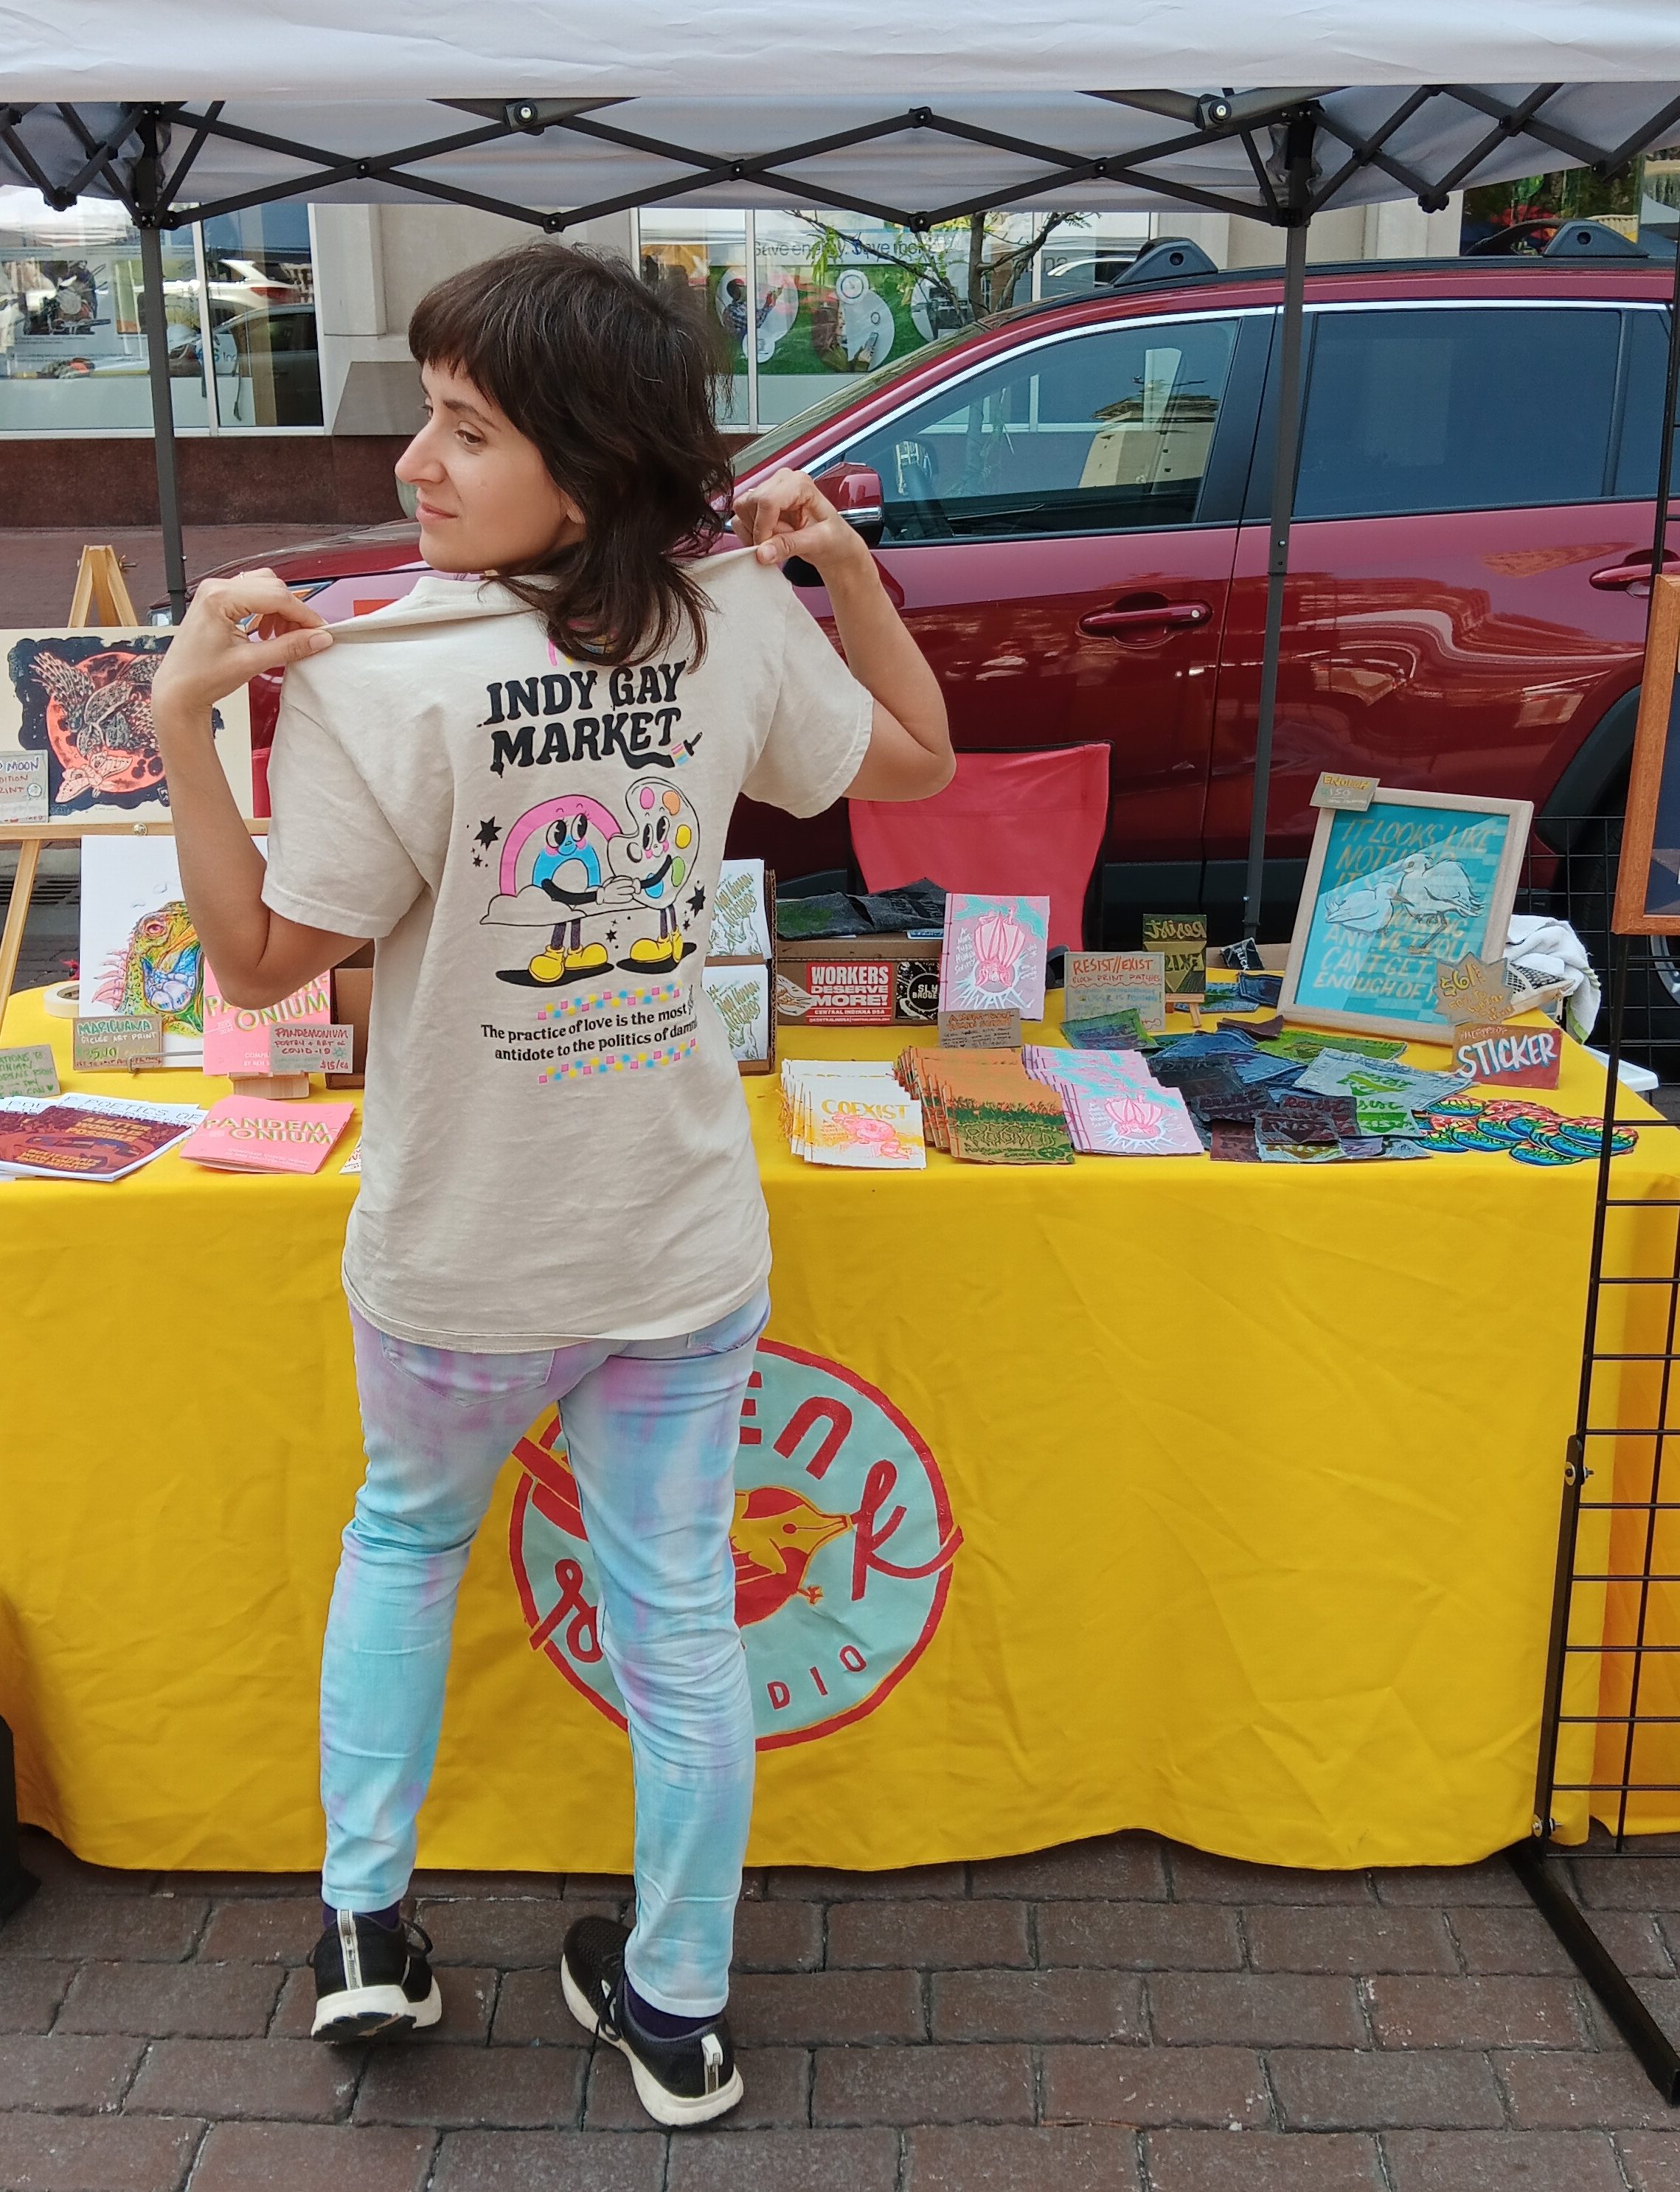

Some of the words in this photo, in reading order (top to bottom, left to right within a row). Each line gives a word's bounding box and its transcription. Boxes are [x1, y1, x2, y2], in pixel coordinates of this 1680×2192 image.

[484, 670, 598, 725] INDY
[609, 660, 687, 710] GAY
[490, 707, 681, 776] MARKET
[7, 757, 39, 771] MOON
[1341, 819, 1374, 842] IT
[1368, 820, 1440, 848] LOOKS
[1443, 825, 1496, 853] LIKE
[1235, 948, 1250, 971] BLICK
[1384, 957, 1433, 979] GET
[811, 966, 889, 985] WORKERS
[1313, 971, 1397, 996] ENOUGH
[1396, 982, 1426, 1000] OF
[811, 985, 889, 994] DESERVE
[811, 994, 888, 1007] MORE!
[275, 1028, 348, 1039] PANDEMONIUM
[481, 1024, 505, 1039] The
[508, 1027, 566, 1044] practice
[569, 1019, 583, 1034] of
[584, 1017, 613, 1031] love
[616, 1014, 628, 1027] is
[631, 1011, 655, 1025] the
[658, 1003, 687, 1022] most
[132, 1032, 156, 1041] PRINT
[495, 1048, 555, 1061] antidote
[558, 1045, 570, 1056] to
[573, 1038, 595, 1052] the
[598, 1033, 651, 1051] politics
[654, 1027, 669, 1041] of
[1456, 1033, 1558, 1079] STICKER
[84, 1098, 169, 1117] POETICS
[176, 1111, 204, 1121] OF
[822, 1099, 912, 1120] COEXIST
[230, 1128, 334, 1145] ONIUM
[768, 1644, 867, 1710] DIO
